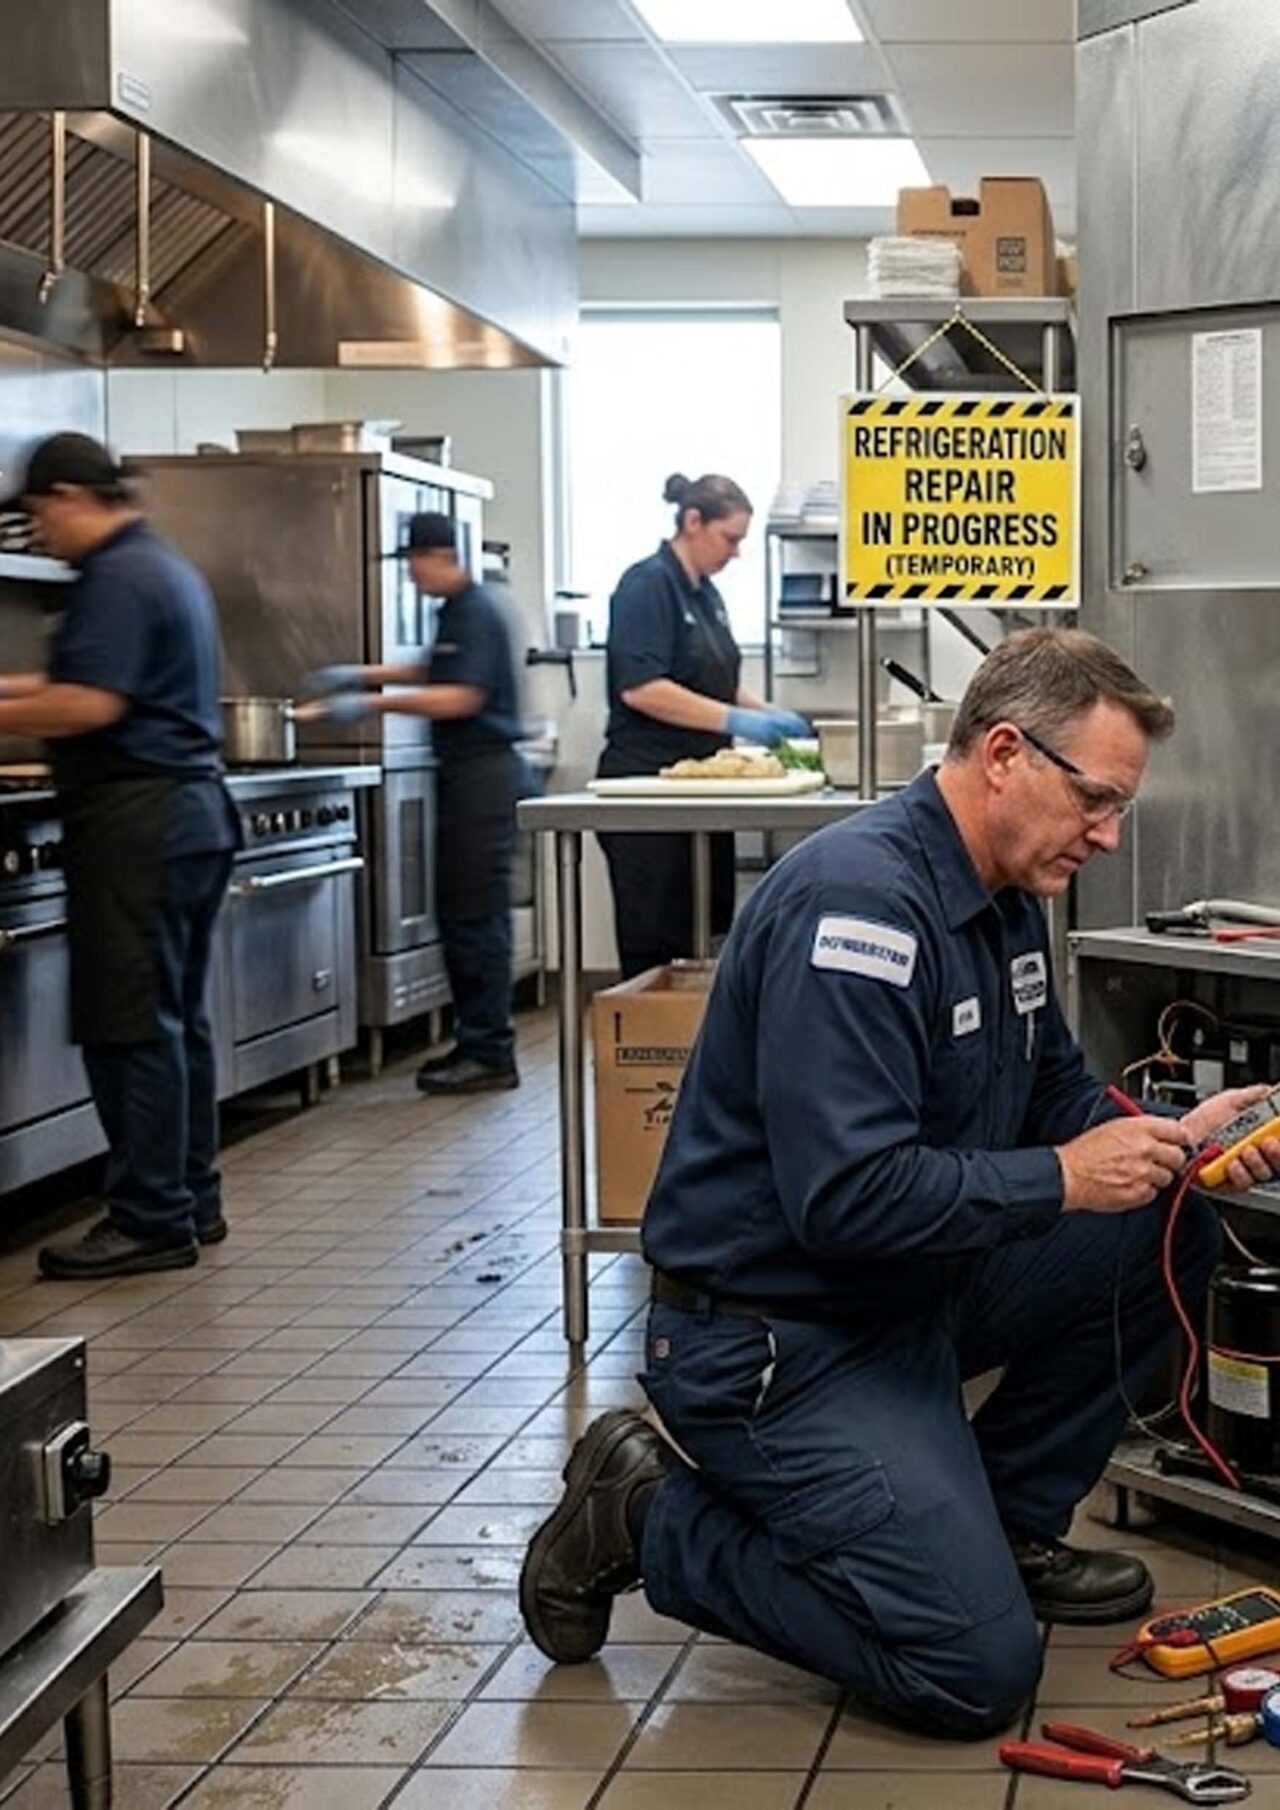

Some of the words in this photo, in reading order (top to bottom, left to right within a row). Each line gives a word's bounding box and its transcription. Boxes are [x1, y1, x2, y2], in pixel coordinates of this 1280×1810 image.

[854, 426, 1066, 460] REFRIGERATION
[904, 469, 1016, 504] REPAIR
[862, 512, 891, 545] IN
[902, 512, 1058, 547] PROGRESS
[885, 554, 1035, 579] (TEMPORARY)
